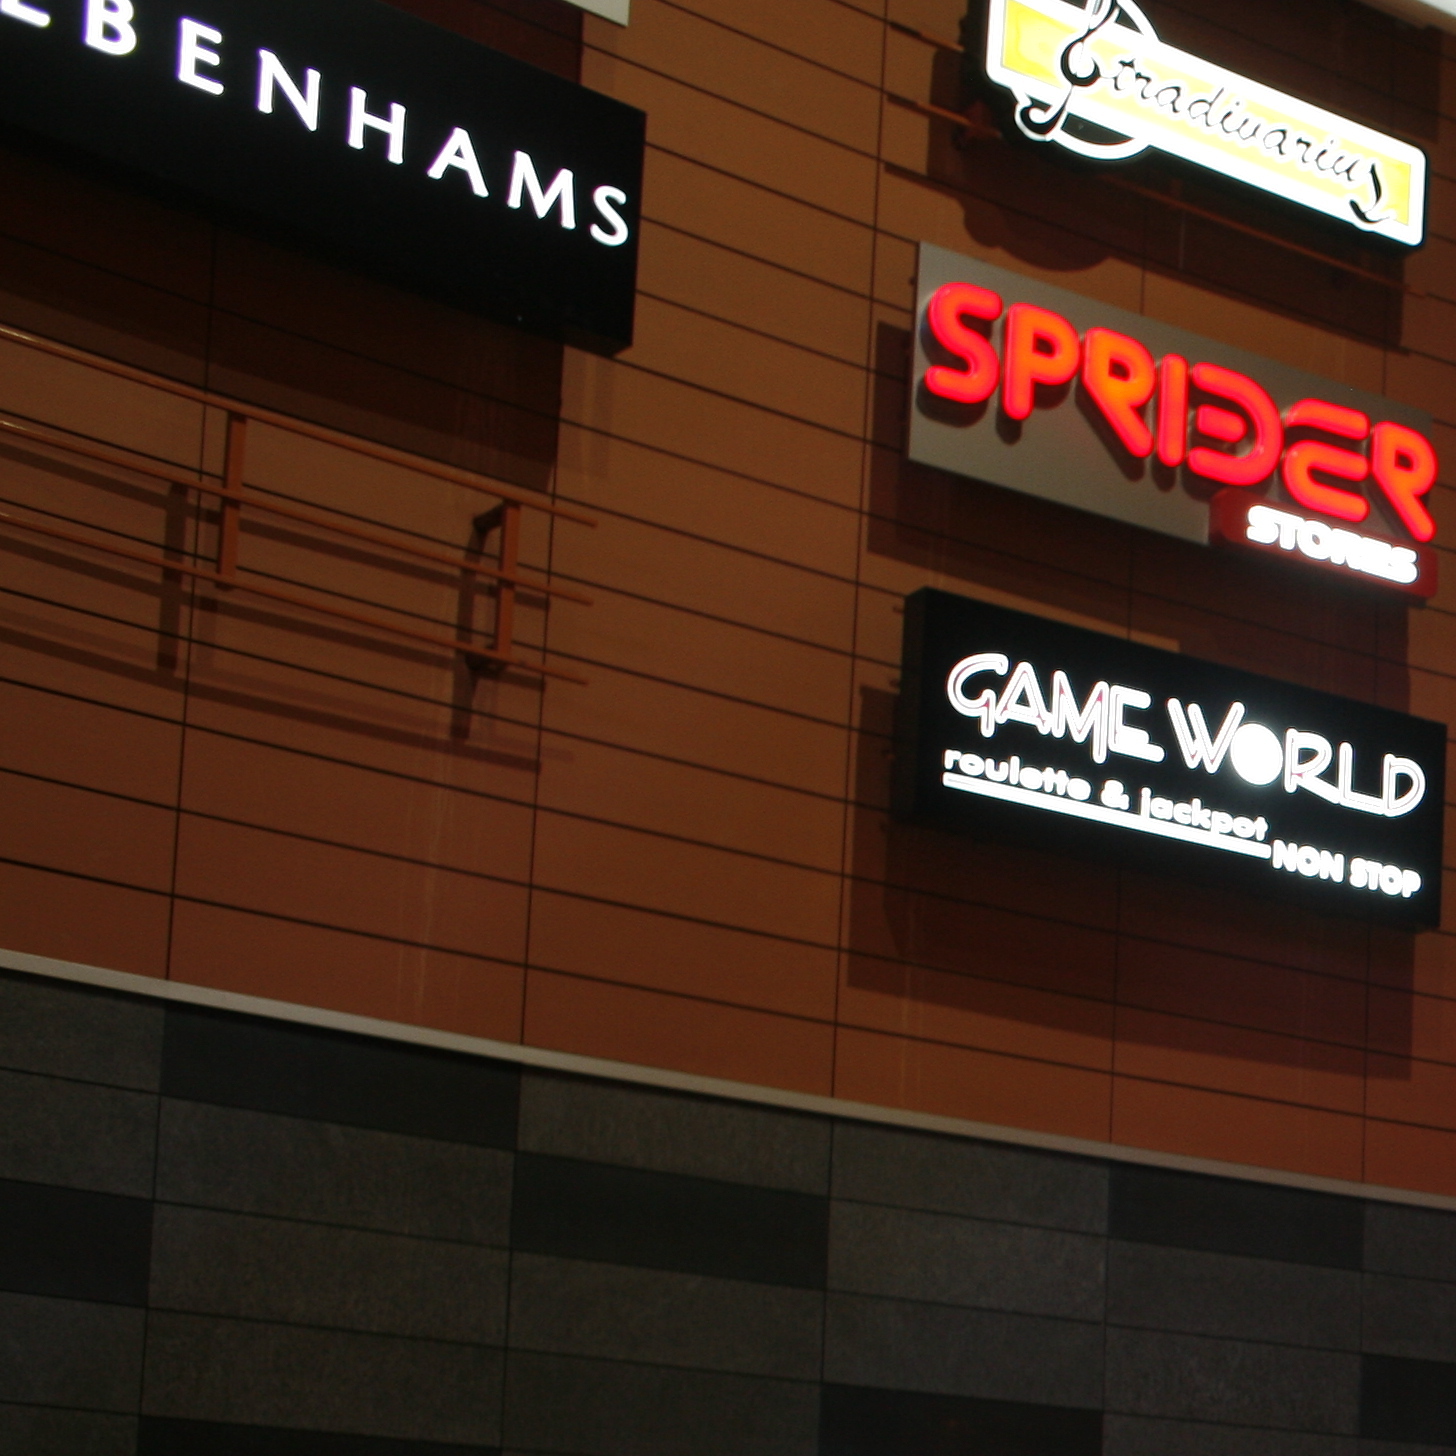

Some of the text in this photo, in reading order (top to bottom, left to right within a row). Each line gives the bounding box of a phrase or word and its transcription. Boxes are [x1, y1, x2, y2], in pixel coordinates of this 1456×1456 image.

[1020, 0, 1394, 223] Stradivarius
[925, 281, 1438, 542] SPRIDER
[1246, 504, 1419, 585] STORES
[943, 748, 1269, 843] roulette & jackpot
[946, 652, 1427, 818] GAME WORLD
[1272, 839, 1422, 898] NON STOP
